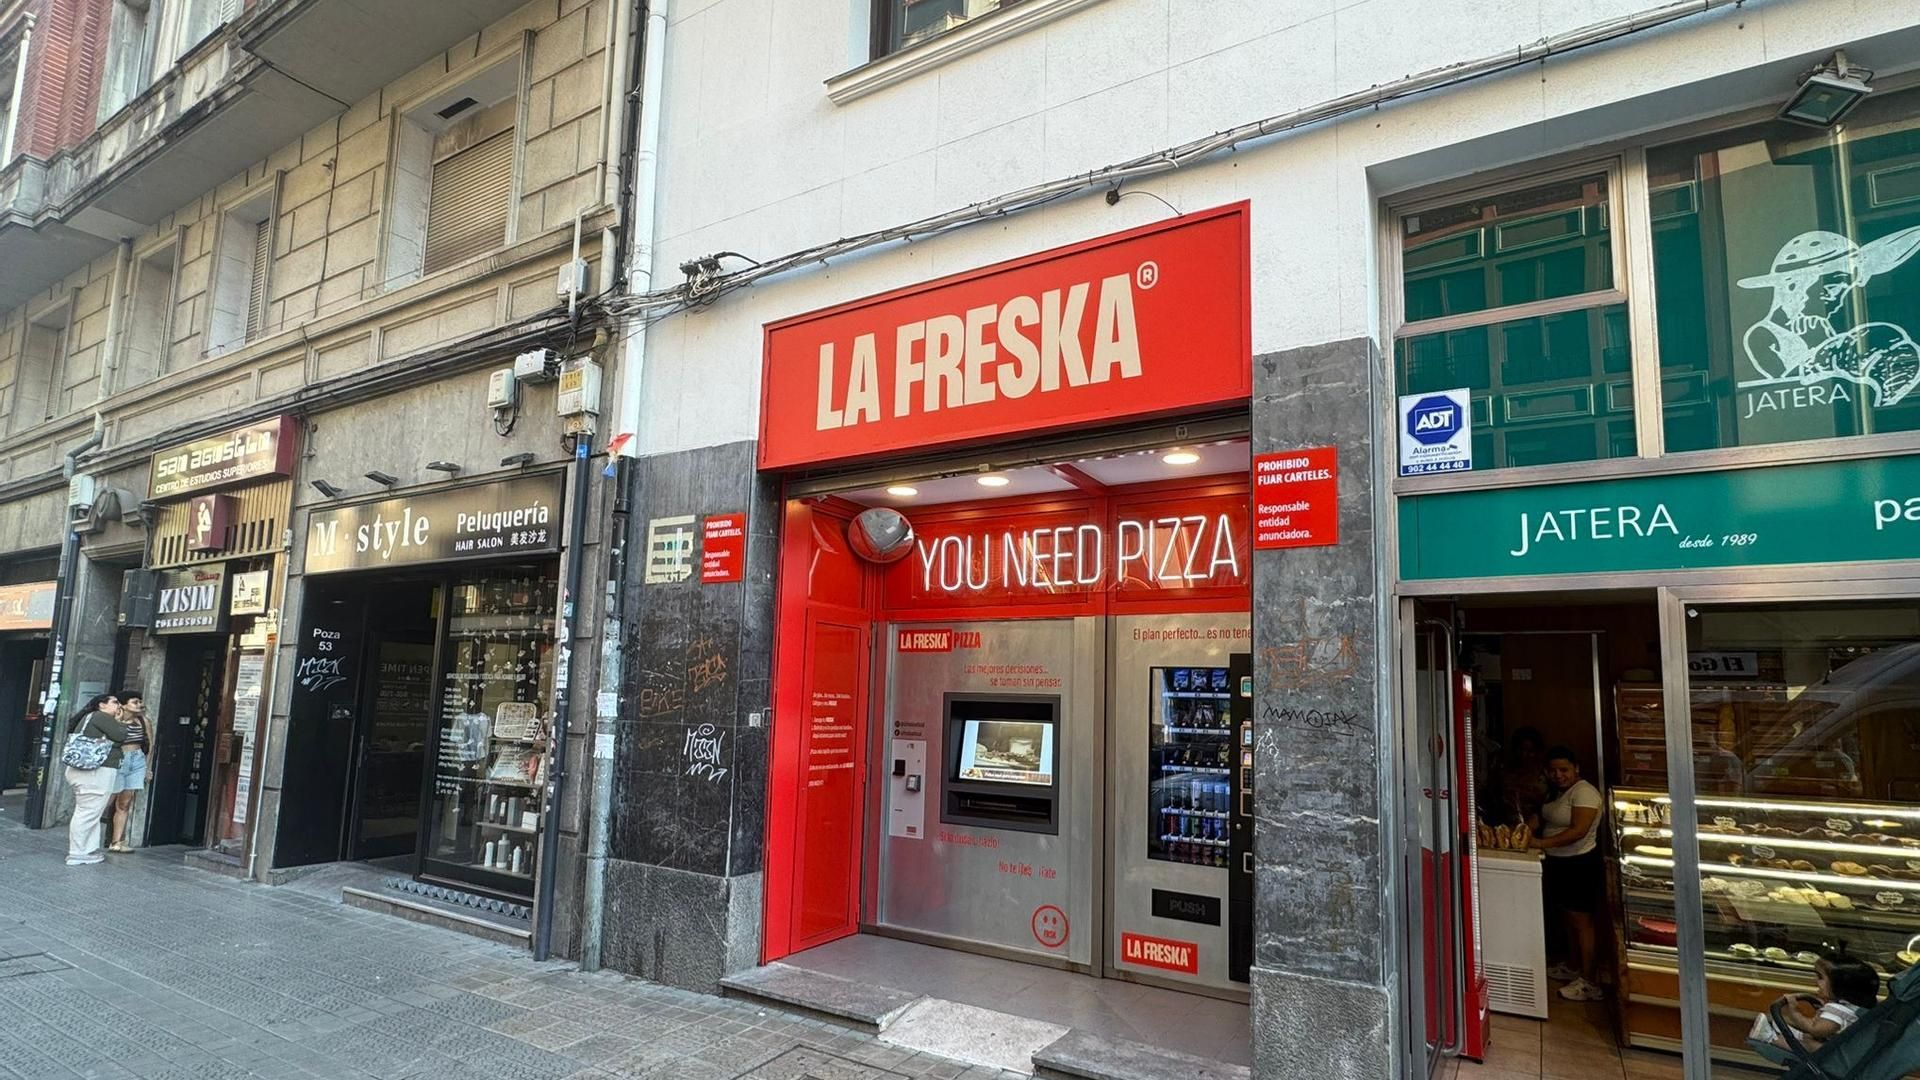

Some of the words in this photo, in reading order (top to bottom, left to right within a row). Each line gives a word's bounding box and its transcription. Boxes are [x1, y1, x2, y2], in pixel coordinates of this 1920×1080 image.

[816, 333, 880, 431] LA
[1744, 384, 1851, 419] JATERA
[1416, 410, 1453, 431] ADT
[1413, 446, 1446, 455] Alarma
[1258, 457, 1310, 473] PROHIBIDO
[1408, 464, 1424, 473] 902
[1426, 463, 1438, 471] 44
[1439, 462, 1451, 470] 44
[1452, 461, 1465, 469] 40
[155, 482, 179, 495] CENTRO
[180, 478, 190, 488] DE
[190, 470, 222, 487] ESTUDIOS
[223, 461, 268, 480] SUPERIORES
[1258, 473, 1283, 486] FIJAR
[1284, 469, 1333, 483] CARTELES.
[1258, 500, 1310, 515] Responsable
[457, 500, 548, 534] Peluquería
[706, 519, 733, 529] PROHIBIDO
[1258, 515, 1290, 528] entidad
[313, 520, 339, 556] M
[356, 507, 430, 559] style
[510, 529, 547, 546] 美发沙龙
[1258, 529, 1312, 541] anunciadora.
[1510, 503, 1680, 557] JATERA
[1679, 533, 1714, 549] desde
[1721, 533, 1758, 547] 1989
[455, 540, 474, 551] HAIR
[477, 536, 504, 549] SALON
[917, 533, 991, 592] YOU
[1003, 523, 1102, 588] NEED
[1117, 513, 1239, 583] PIZZA
[159, 584, 216, 614] KISIM
[313, 627, 341, 639] Poza
[900, 633, 912, 648] LA
[913, 632, 948, 649] FRESKA
[954, 631, 981, 648] PIZZA
[1133, 628, 1141, 640] El
[1142, 628, 1160, 642] plan
[1206, 629, 1217, 639] es
[1219, 629, 1231, 639] no
[318, 641, 333, 651] 53
[976, 664, 1004, 676] mejores
[990, 678, 998, 687] se
[999, 677, 1022, 687] toman
[1022, 677, 1034, 687] sin
[1169, 899, 1206, 916] PUSH
[1126, 938, 1142, 959] LA
[1143, 940, 1189, 968] FRESKA
